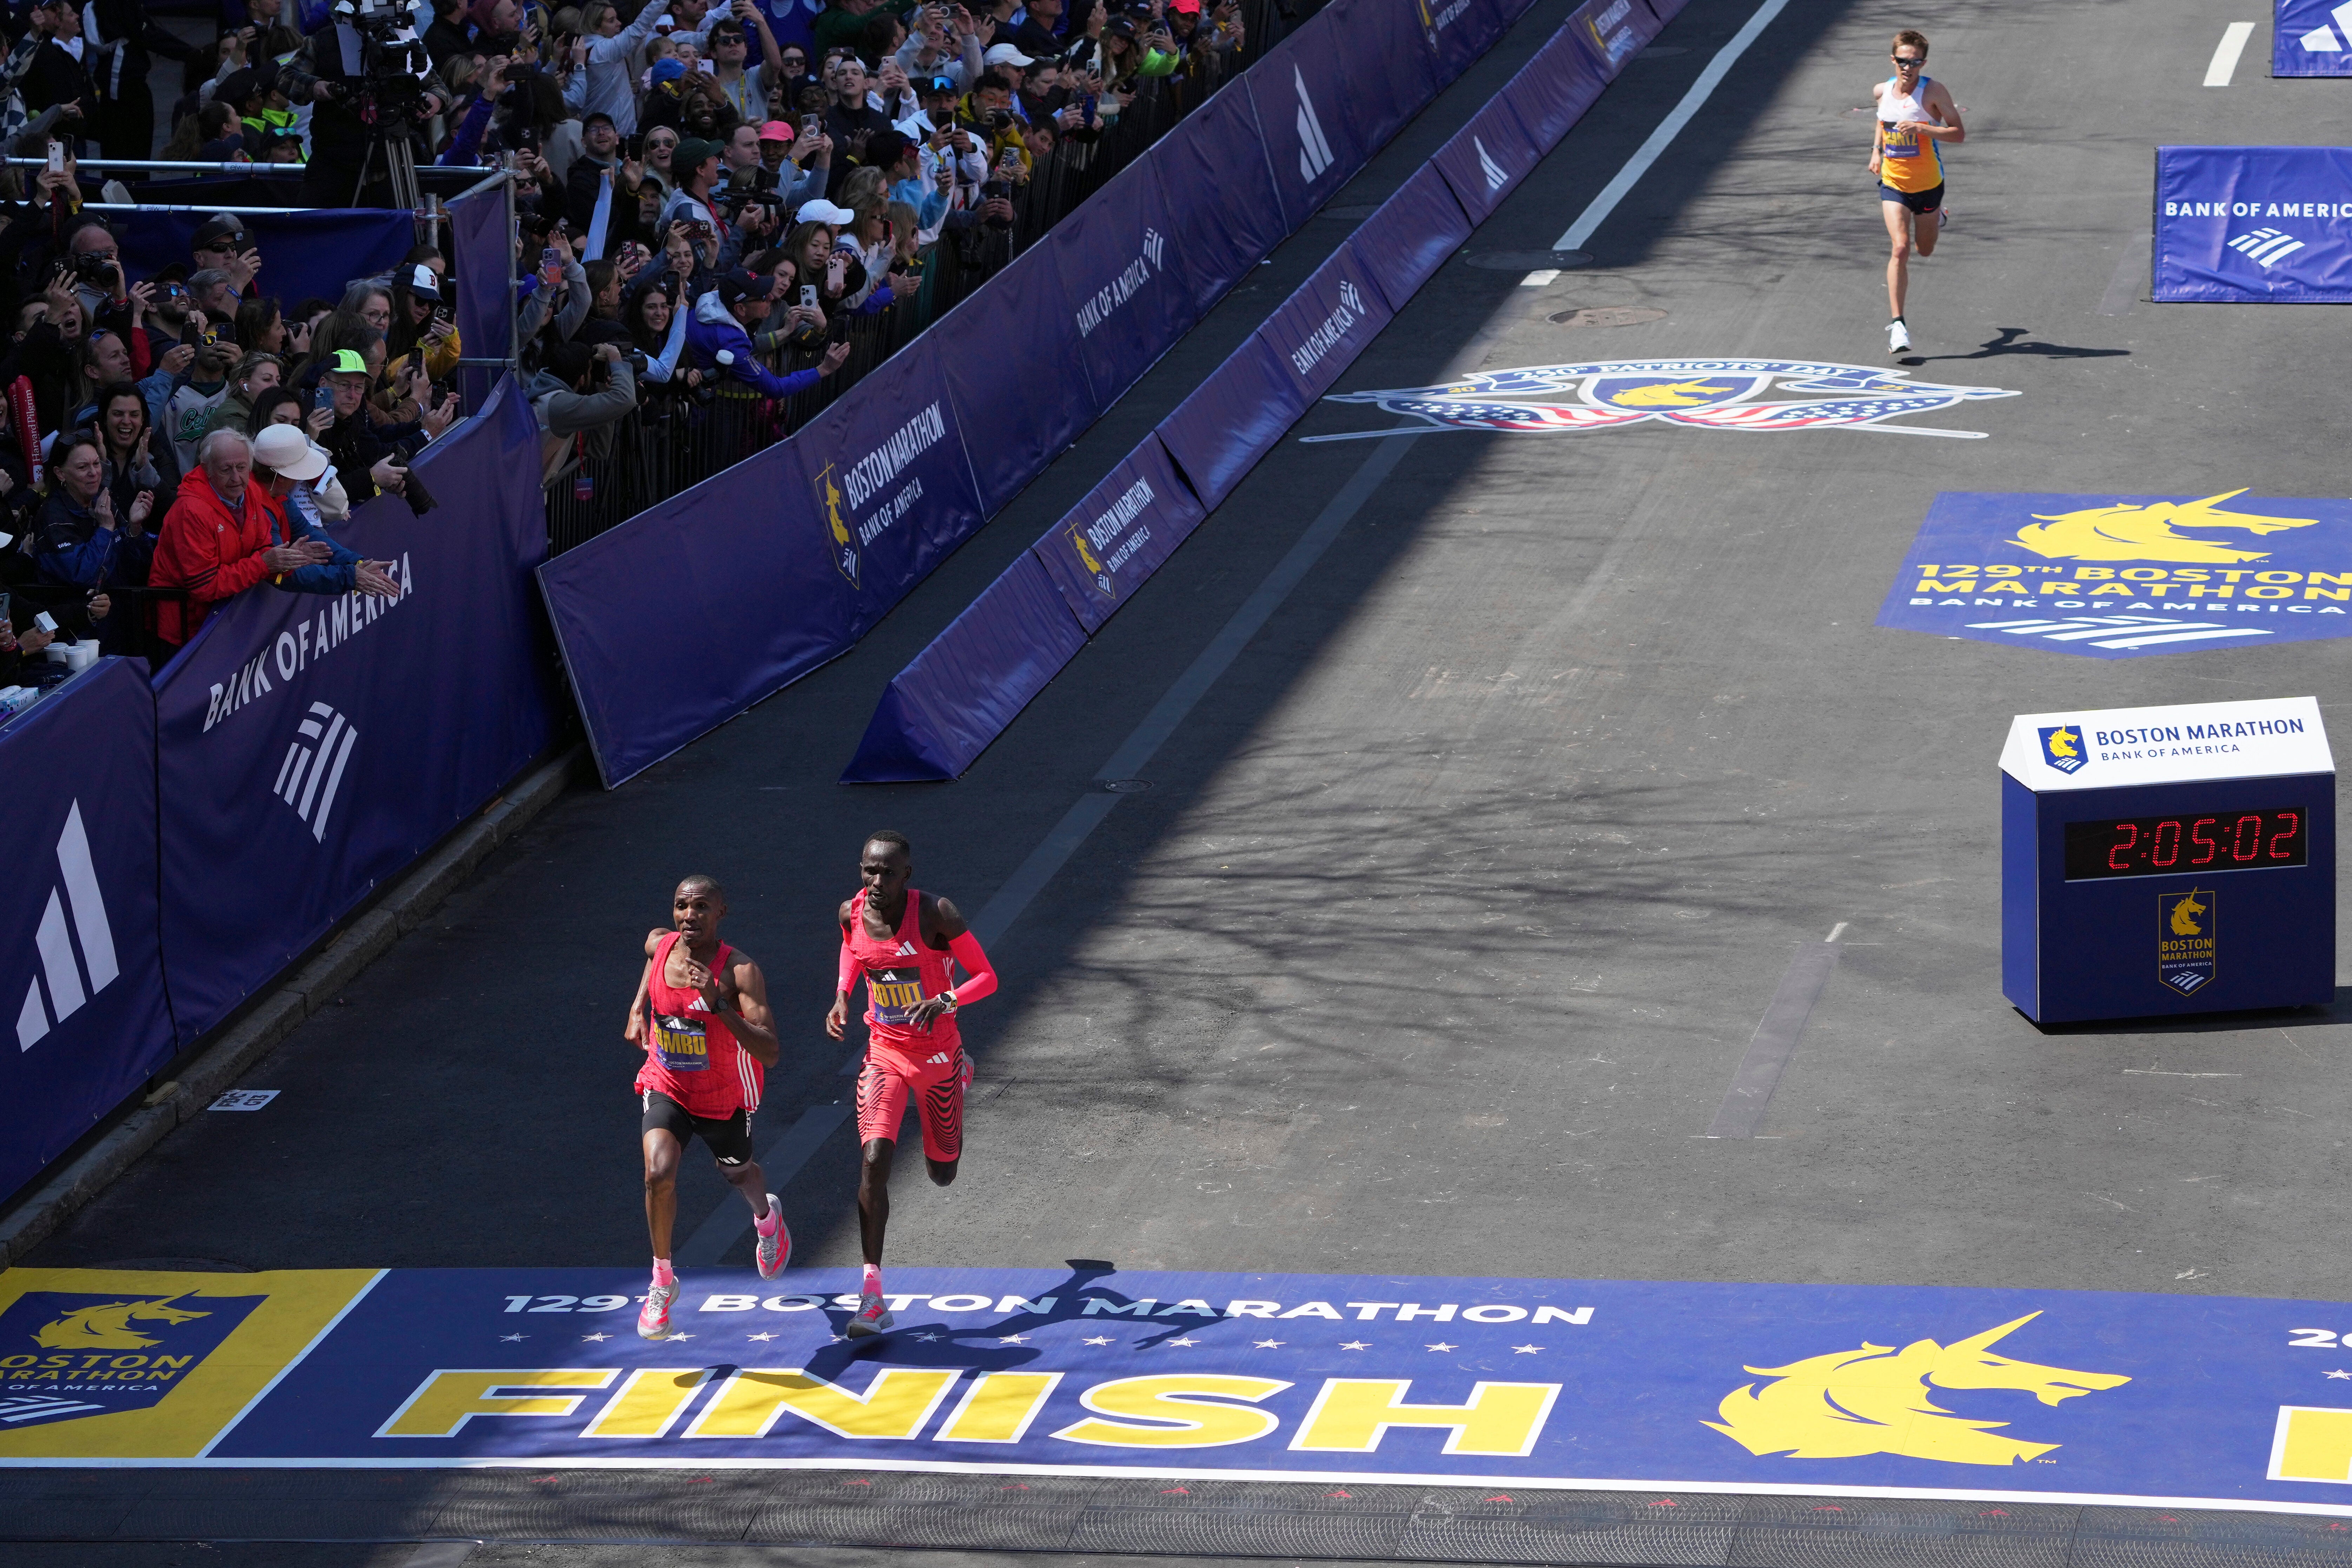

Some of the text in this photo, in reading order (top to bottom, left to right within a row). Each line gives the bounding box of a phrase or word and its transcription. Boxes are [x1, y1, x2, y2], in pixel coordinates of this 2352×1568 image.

[2165, 202, 2352, 218] BANK OF AMERIC
[429, 274, 436, 286] B
[1076, 297, 1102, 338] BANK
[1098, 286, 1112, 316] OF
[1310, 332, 1327, 356] OF
[1787, 364, 1860, 377] DAY
[844, 401, 945, 510] BOSTON MARATHON
[859, 477, 923, 546] BANK OF AMERICA
[1087, 477, 1155, 551] BOSTON MARATHON
[1107, 525, 1151, 573] BANK OF AMERICA
[1917, 564, 2352, 585] 129TH BOSTON
[1916, 580, 2351, 601] MARATHON
[1909, 598, 2039, 607] BANK
[2126, 602, 2346, 614] AMERICA
[203, 644, 272, 733] BANK
[276, 619, 310, 681] OF
[2096, 719, 2304, 746] BOSTON MARATHON
[2101, 744, 2240, 761] BANK OF AMERICA
[2109, 813, 2298, 869] 2:05:02
[2161, 938, 2212, 952] BOSTON
[2161, 950, 2212, 961] MARATHON
[870, 980, 922, 1007] KOTUT
[504, 1294, 1595, 1324] 129T BOSTON MARATHON
[2288, 1329, 2352, 1348] 2
[0, 1355, 194, 1368] OSTON
[0, 1370, 177, 1380] RATHON
[372, 1368, 1563, 1457] FINISH
